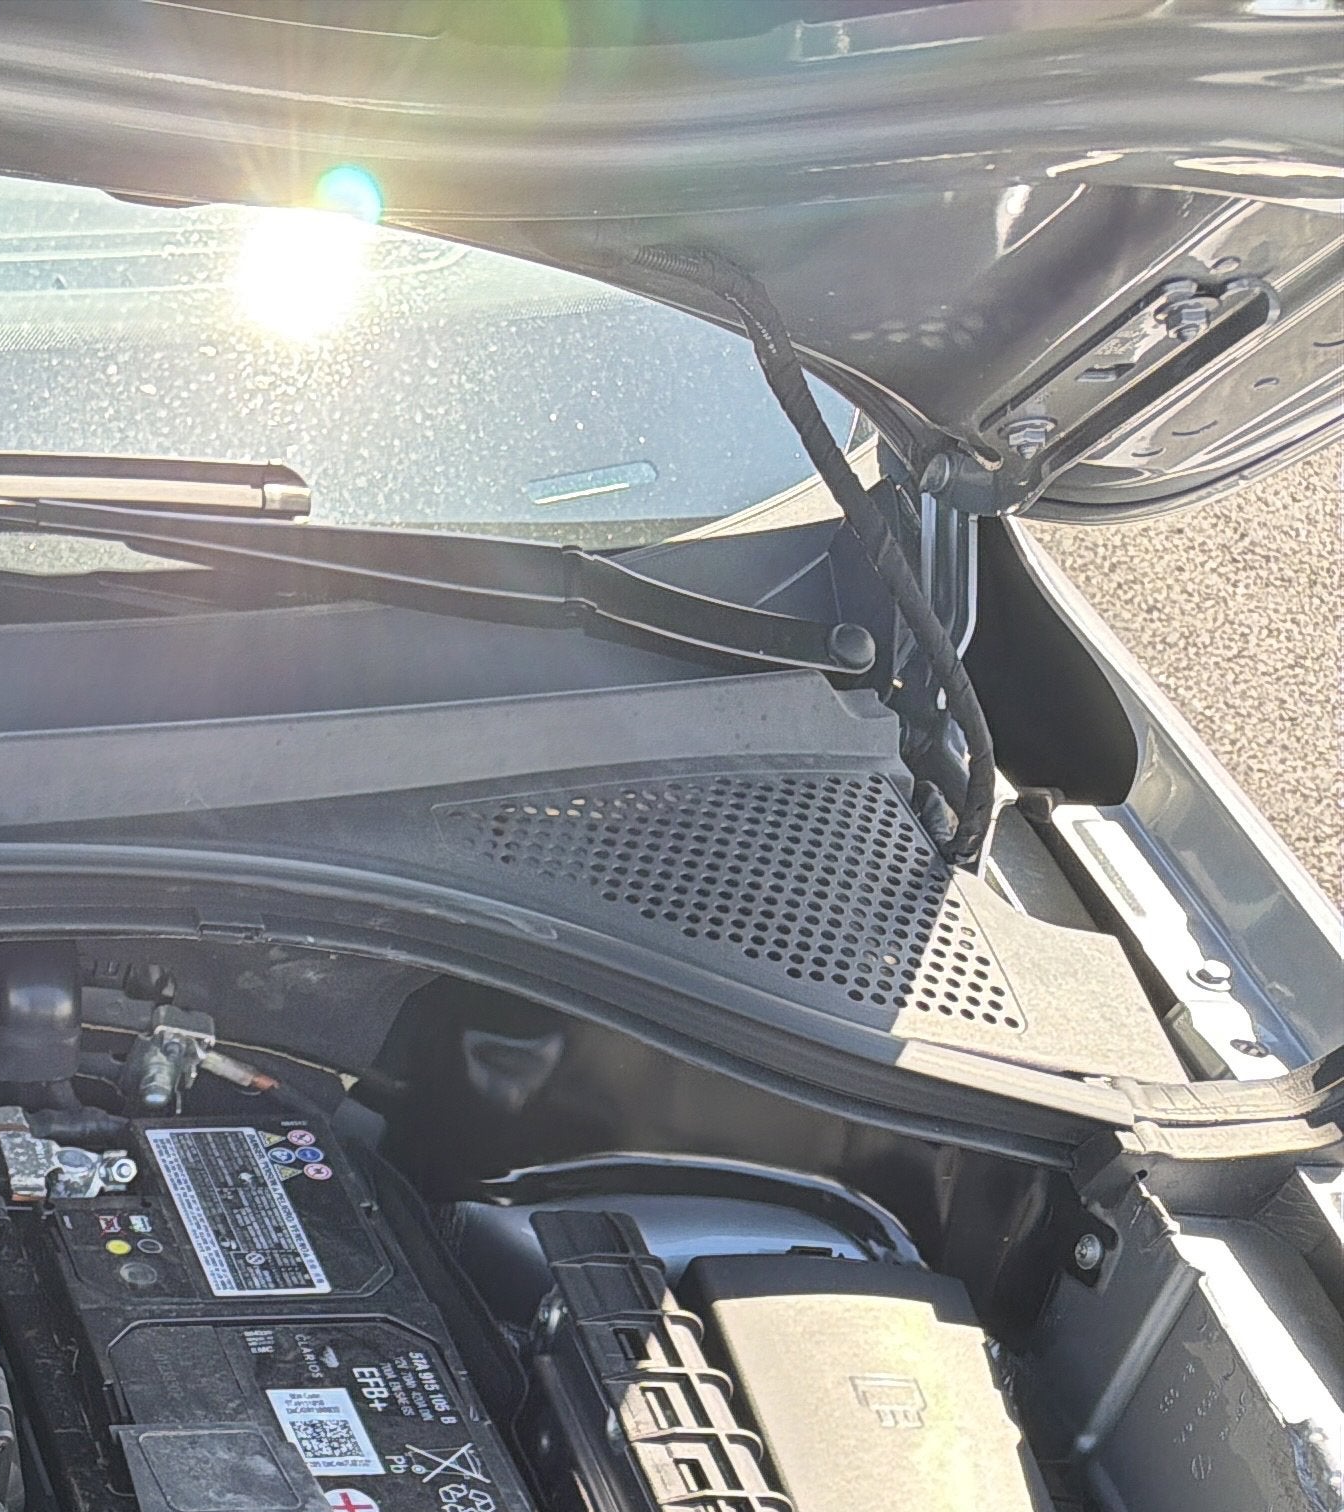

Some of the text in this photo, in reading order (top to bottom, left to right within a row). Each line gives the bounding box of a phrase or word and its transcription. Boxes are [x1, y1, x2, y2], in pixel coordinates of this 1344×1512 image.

[294, 1333, 323, 1379] CLARIOS
[352, 1367, 390, 1412] EFB+
[408, 1351, 459, 1425] 5TA 915 105 B
[385, 1455, 409, 1474] Pb
